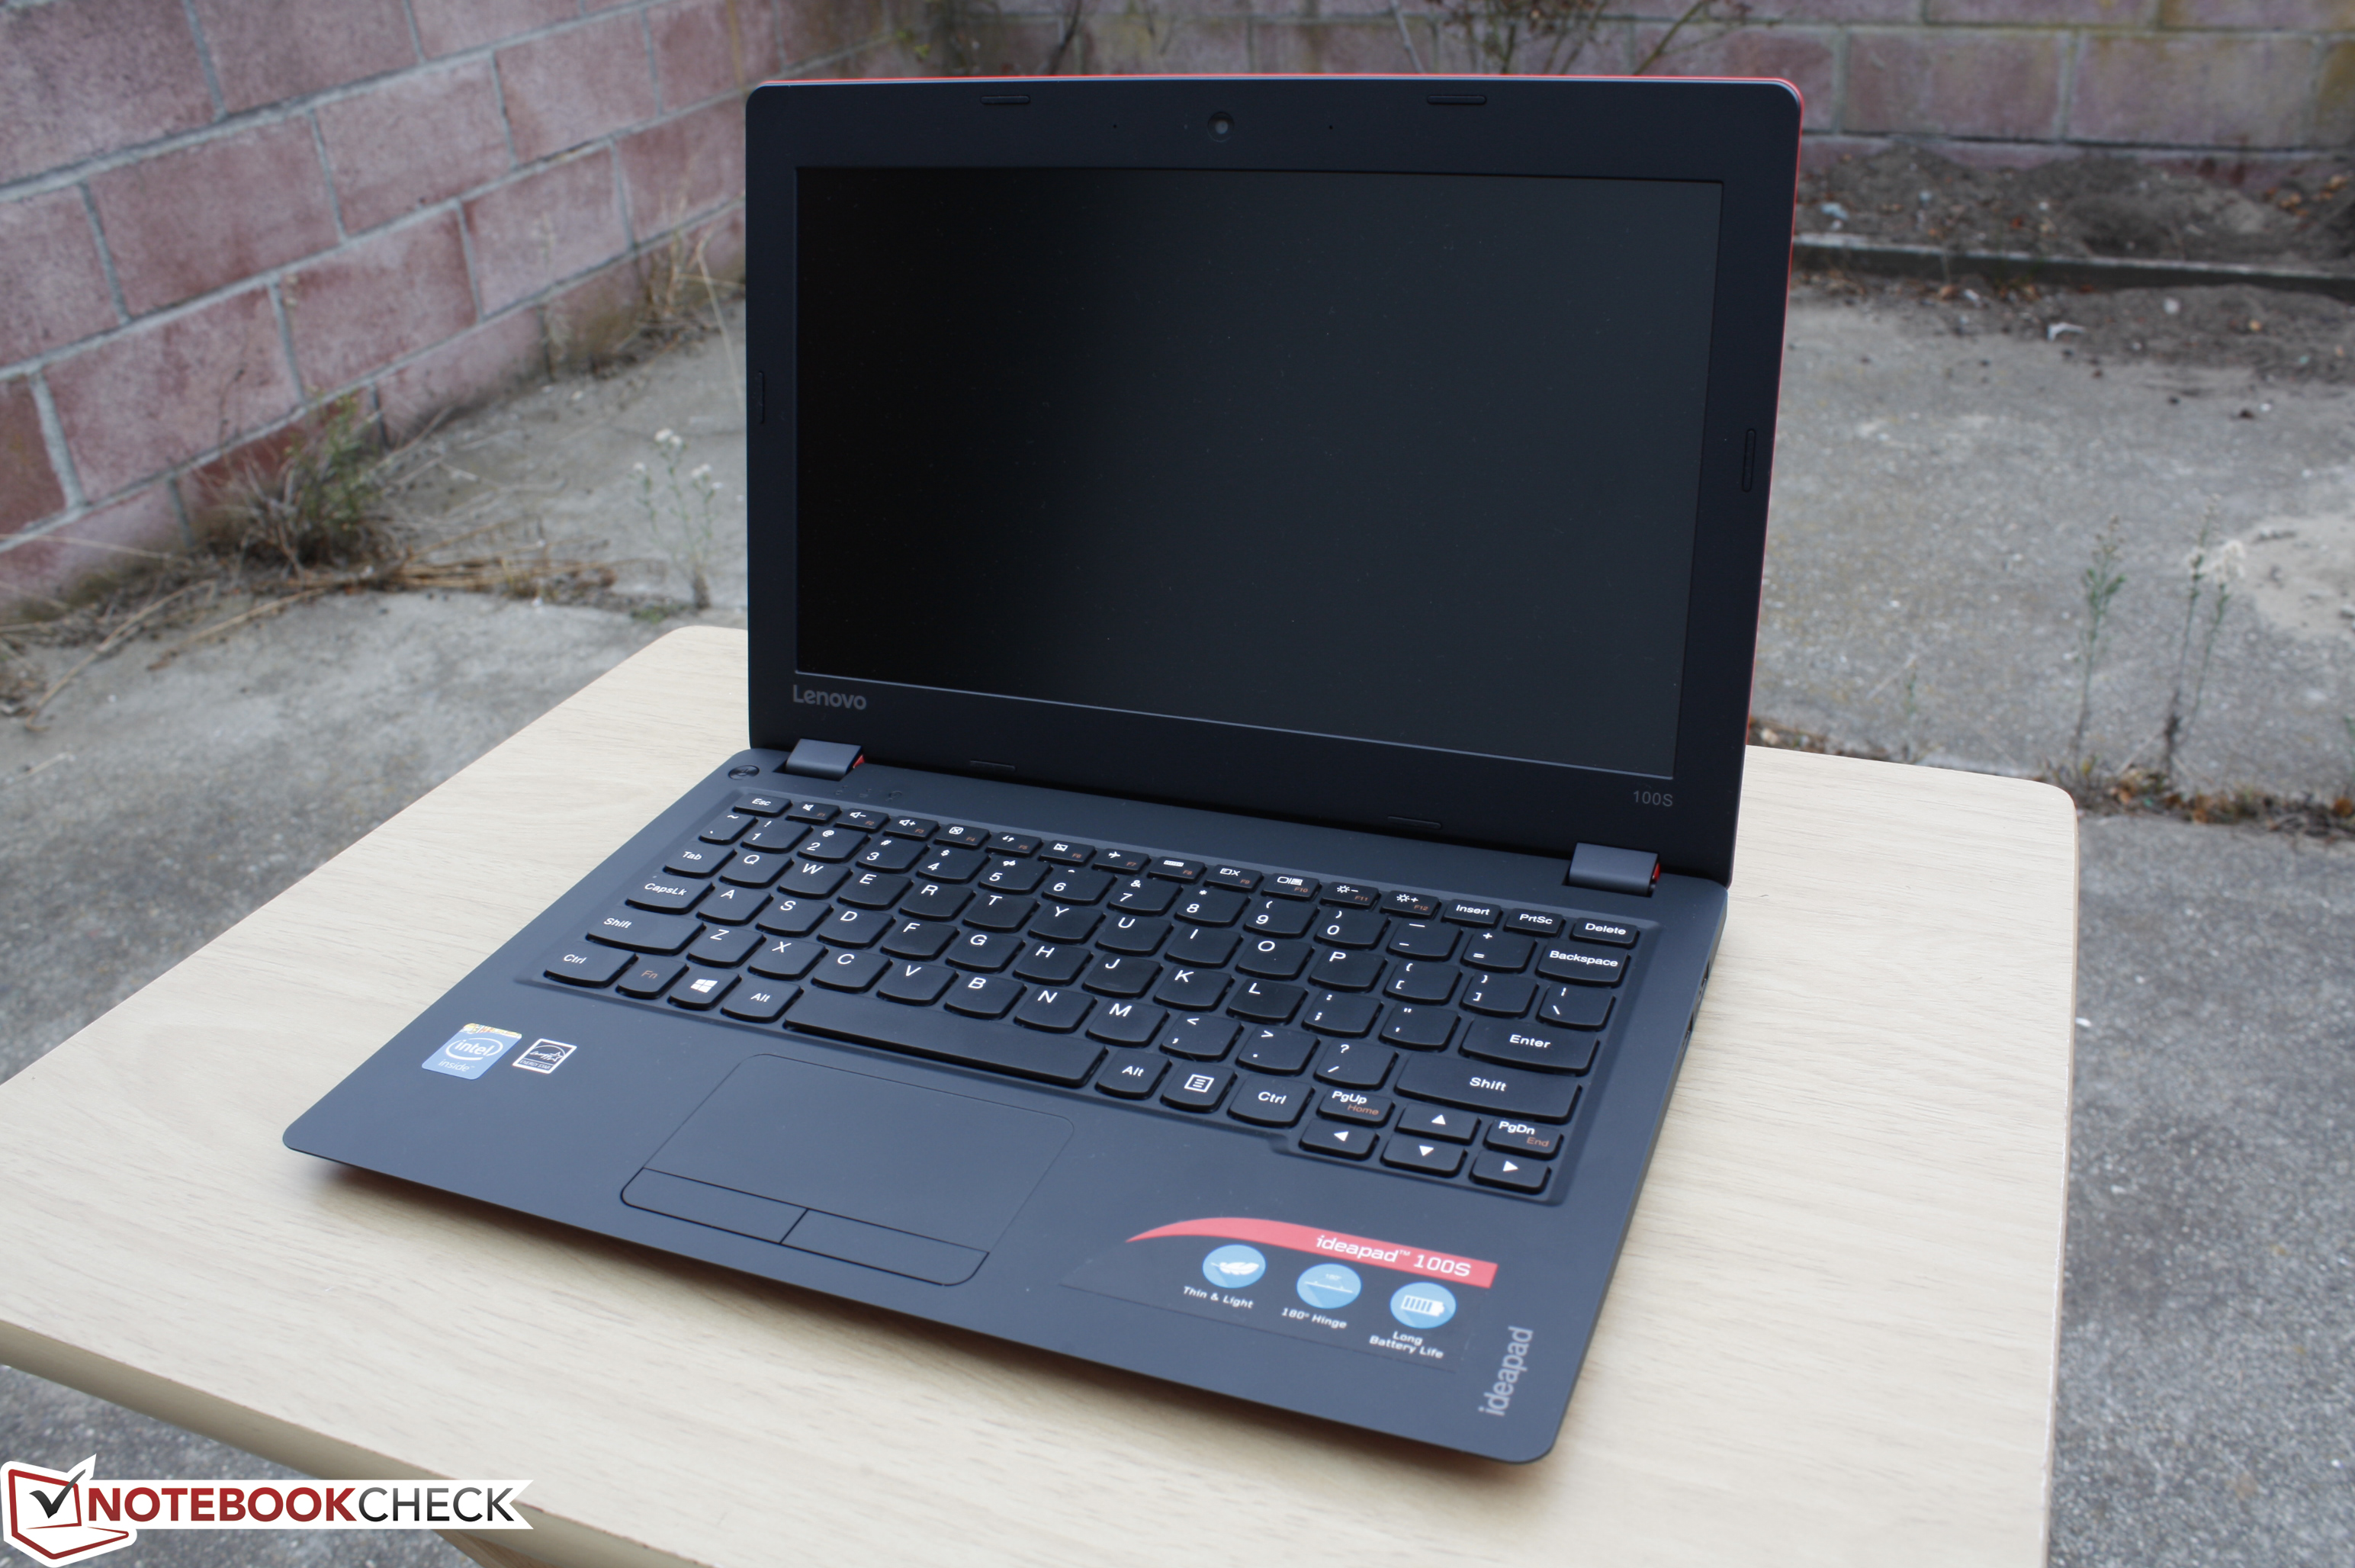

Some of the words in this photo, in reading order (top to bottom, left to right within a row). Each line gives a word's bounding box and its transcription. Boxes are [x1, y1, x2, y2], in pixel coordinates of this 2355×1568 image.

[792, 684, 867, 711] Lenovo
[751, 798, 772, 806] Esc
[1633, 790, 1673, 807] 100S
[752, 832, 762, 841] 1
[806, 842, 821, 851] 2
[683, 850, 702, 860] Tab
[744, 854, 760, 865] Q
[866, 851, 880, 861] 3
[802, 863, 824, 875] W
[927, 862, 940, 871] 4
[859, 873, 877, 885] E
[988, 872, 1003, 882] 5
[644, 882, 687, 896] CapsLk
[1053, 882, 1067, 892] 6
[1130, 879, 1142, 888] &
[720, 889, 735, 899] A
[920, 884, 939, 896] R
[988, 895, 1003, 906] T
[1120, 892, 1133, 902] 7
[779, 900, 796, 911] S
[1186, 903, 1200, 914] 8
[1265, 900, 1274, 909] (
[1455, 904, 1490, 916] Insert
[840, 911, 858, 922] D
[1055, 905, 1070, 917] Y
[1335, 910, 1343, 919] )
[603, 917, 632, 929] Shift
[1117, 917, 1136, 929] U
[1255, 914, 1269, 925] 9
[1519, 913, 1553, 925] PrtSc
[902, 922, 920, 933] F
[1326, 924, 1340, 936] 0
[1585, 923, 1627, 935] Delete
[709, 928, 730, 941] Z
[969, 933, 988, 946] G
[1190, 928, 1199, 940] I
[771, 941, 792, 953] X
[1035, 946, 1055, 958] H
[1258, 940, 1276, 952] O
[563, 953, 587, 964] Ctrl
[837, 953, 855, 965] C
[1329, 951, 1347, 962] P
[1549, 949, 1618, 967] Backspace
[1104, 958, 1121, 969] J
[1406, 962, 1413, 972] {
[641, 969, 658, 979] Fn
[905, 965, 922, 977] V
[1174, 969, 1194, 983] K
[967, 976, 987, 989] B
[1395, 980, 1405, 990] [
[1480, 975, 1489, 984] }
[1248, 982, 1261, 995] L
[750, 992, 771, 1003] Alt
[1037, 990, 1058, 1004] N
[1473, 991, 1483, 1002] ]
[1108, 1003, 1133, 1017] M
[1314, 1011, 1322, 1021] ;
[1553, 1005, 1560, 1015] \
[1187, 1017, 1200, 1026] <
[1261, 1030, 1274, 1038] >
[1509, 1033, 1551, 1049] Enter
[455, 1039, 496, 1057] intel
[1340, 1043, 1350, 1054] ?
[439, 1059, 471, 1072] inside
[1121, 1065, 1144, 1077] Alt
[1469, 1077, 1507, 1092] Shift
[1258, 1091, 1287, 1104] Ctrl
[1332, 1090, 1367, 1105] PgUp
[1348, 1104, 1380, 1116] Home
[1498, 1120, 1535, 1136] PgDn
[1527, 1136, 1550, 1148] End
[1412, 1253, 1472, 1277] 100S
[1183, 1285, 1208, 1300] Thin
[1210, 1292, 1219, 1302] &
[1222, 1293, 1255, 1309] Light
[1312, 1313, 1348, 1329] Hinge
[1393, 1330, 1424, 1346] Long
[1369, 1335, 1417, 1354] Battery
[1418, 1345, 1444, 1359] Life
[1477, 1325, 1534, 1417] ideapad
